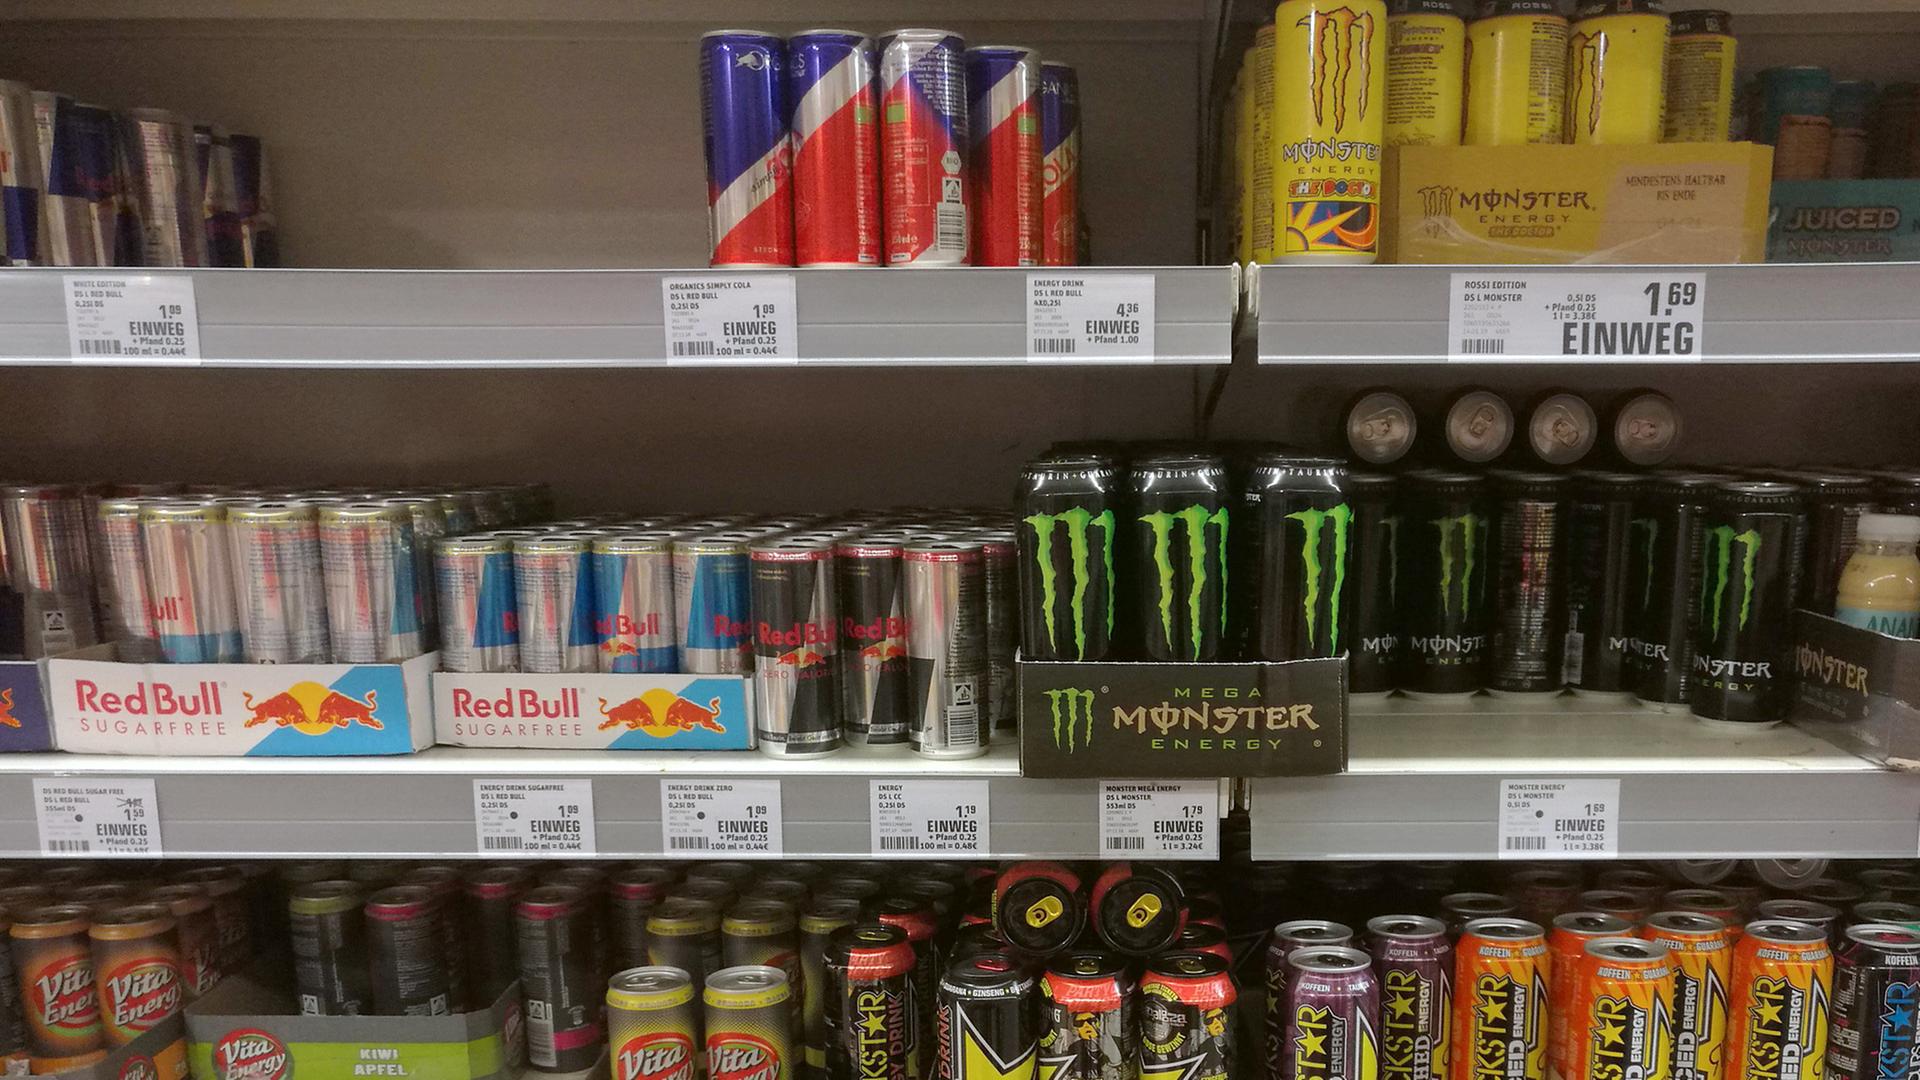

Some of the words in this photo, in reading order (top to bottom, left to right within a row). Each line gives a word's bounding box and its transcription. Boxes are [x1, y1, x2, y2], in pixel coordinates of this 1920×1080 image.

[1298, 166, 1375, 175] ENERGY
[1626, 175, 1682, 186] MINDESTENS
[1684, 175, 1726, 186] HALTBAR
[1460, 188, 1591, 212] MONSTER
[1673, 190, 1696, 200] ENDE
[1480, 214, 1571, 223] ENERGY
[1788, 207, 1902, 230] JUICED
[1788, 237, 1892, 255] MONSTER
[1464, 281, 1491, 289] ROSSI
[1492, 281, 1527, 289] EDITION
[1643, 282, 1697, 316] 1.69
[159, 304, 182, 319] 1.09
[753, 304, 775, 318] 1.09
[1117, 303, 1139, 317] 4.36
[1552, 303, 1575, 311] Pfand
[1572, 312, 1596, 320] 3.38€
[129, 322, 184, 336] EINWEG
[724, 321, 776, 335] EINWEG
[1086, 320, 1139, 334] EINWEG
[140, 337, 163, 345] Pfand
[733, 337, 756, 345] Pfand
[1563, 322, 1694, 355] EINWEG
[124, 347, 139, 355] 100
[142, 347, 153, 355] ml
[717, 347, 732, 355] 100
[734, 347, 744, 355] ml
[753, 347, 778, 355] 0.44€
[616, 612, 660, 637] Bull
[845, 617, 883, 639] Red
[759, 620, 802, 646] Red
[75, 679, 149, 716] Red
[154, 681, 223, 717] Bull
[1174, 687, 1262, 698] MEGA
[452, 688, 515, 719] Red
[519, 688, 580, 719] Bull
[1112, 701, 1320, 736] MONSTER
[80, 717, 228, 736] SUGARFREE
[454, 723, 583, 737] SUGARFREE
[1151, 739, 1282, 751] ENERGY
[124, 808, 144, 821] 1.59
[558, 805, 578, 818] 1.09
[746, 806, 767, 818] 1.09
[956, 805, 976, 818] 1.19
[1182, 806, 1202, 818] 1.79
[1584, 804, 1604, 816] 1.69
[96, 824, 147, 836] EINWEG
[531, 820, 580, 832] EINWEG
[718, 821, 768, 833] EINWEG
[928, 820, 977, 832] EINWEG
[1154, 821, 1203, 833] EINWEG
[1555, 819, 1605, 832] EINWEG
[1389, 949, 1418, 958] KOFFEIN
[1479, 946, 1511, 958] KOFFEIN
[1757, 948, 1789, 961] KOFFEIN
[1885, 954, 1919, 966] KOFFEIN
[1597, 966, 1632, 980] KOFFEIN
[106, 965, 174, 1005] Vita
[1301, 982, 1331, 993] KOFFEIN
[972, 988, 1006, 997] GINSENG
[1418, 981, 1431, 1033] ENERGY
[1683, 979, 1698, 1030] ENERGY
[1513, 985, 1526, 1038] ENERGY
[1788, 990, 1804, 1042] ENERGY
[888, 998, 904, 1057] DRINK
[1631, 1009, 1645, 1063] ENERGY
[220, 1039, 274, 1065] Vita
[1331, 1018, 1345, 1075] ENERGY
[360, 1048, 399, 1060] KIWI
[708, 1044, 768, 1073] Vita
[620, 1044, 688, 1080] Vita
[354, 1063, 408, 1076] APFEL
